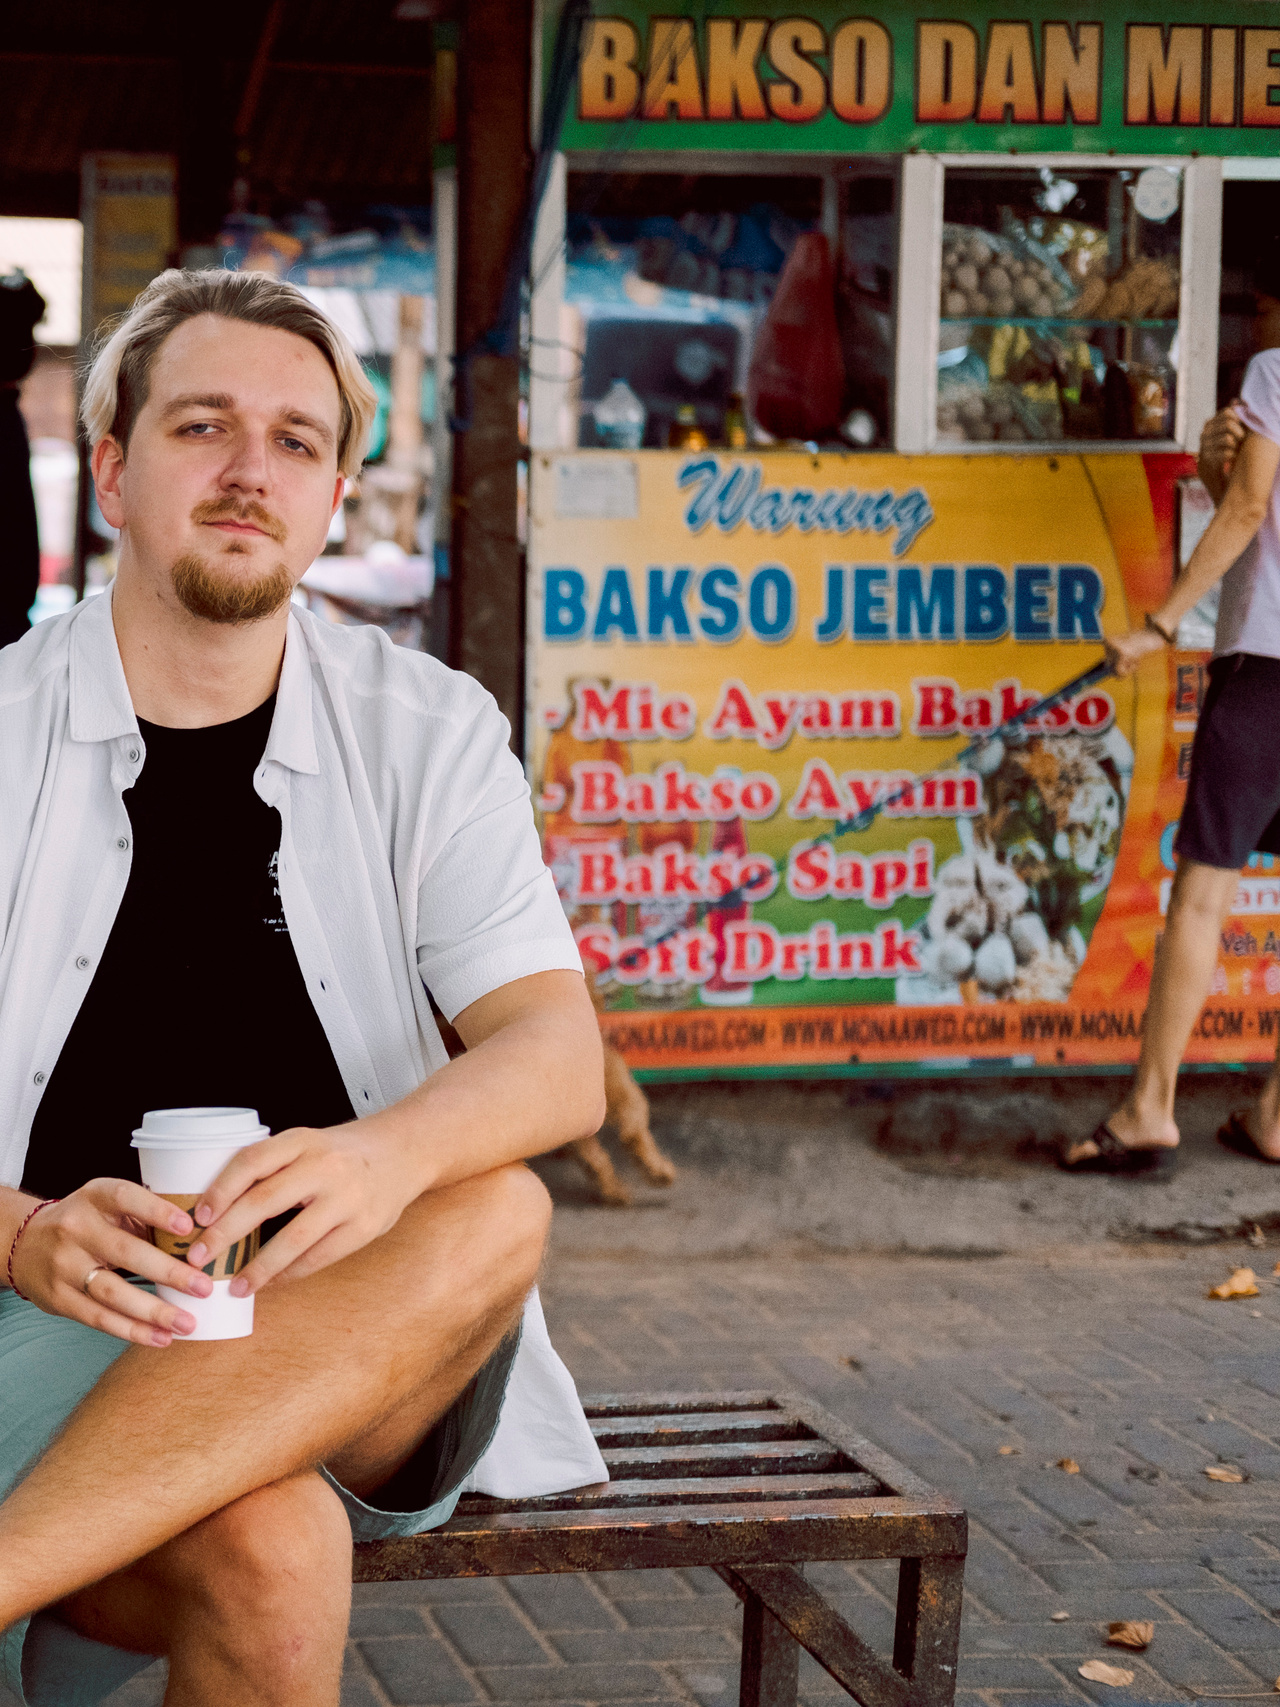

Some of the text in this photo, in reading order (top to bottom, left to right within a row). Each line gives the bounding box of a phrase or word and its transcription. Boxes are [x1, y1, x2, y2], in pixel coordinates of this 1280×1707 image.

[577, 17, 1280, 128] BAKSO DAN MIE
[677, 452, 935, 558] Warung
[542, 563, 1107, 645] BAKSO JEMBER
[576, 683, 694, 738] Mie
[710, 684, 898, 748] Ayam
[913, 679, 1114, 735] Bakso
[577, 765, 981, 822] Bakso Ayam
[577, 841, 934, 904] Bakso Sapi
[728, 922, 923, 973] Drink
